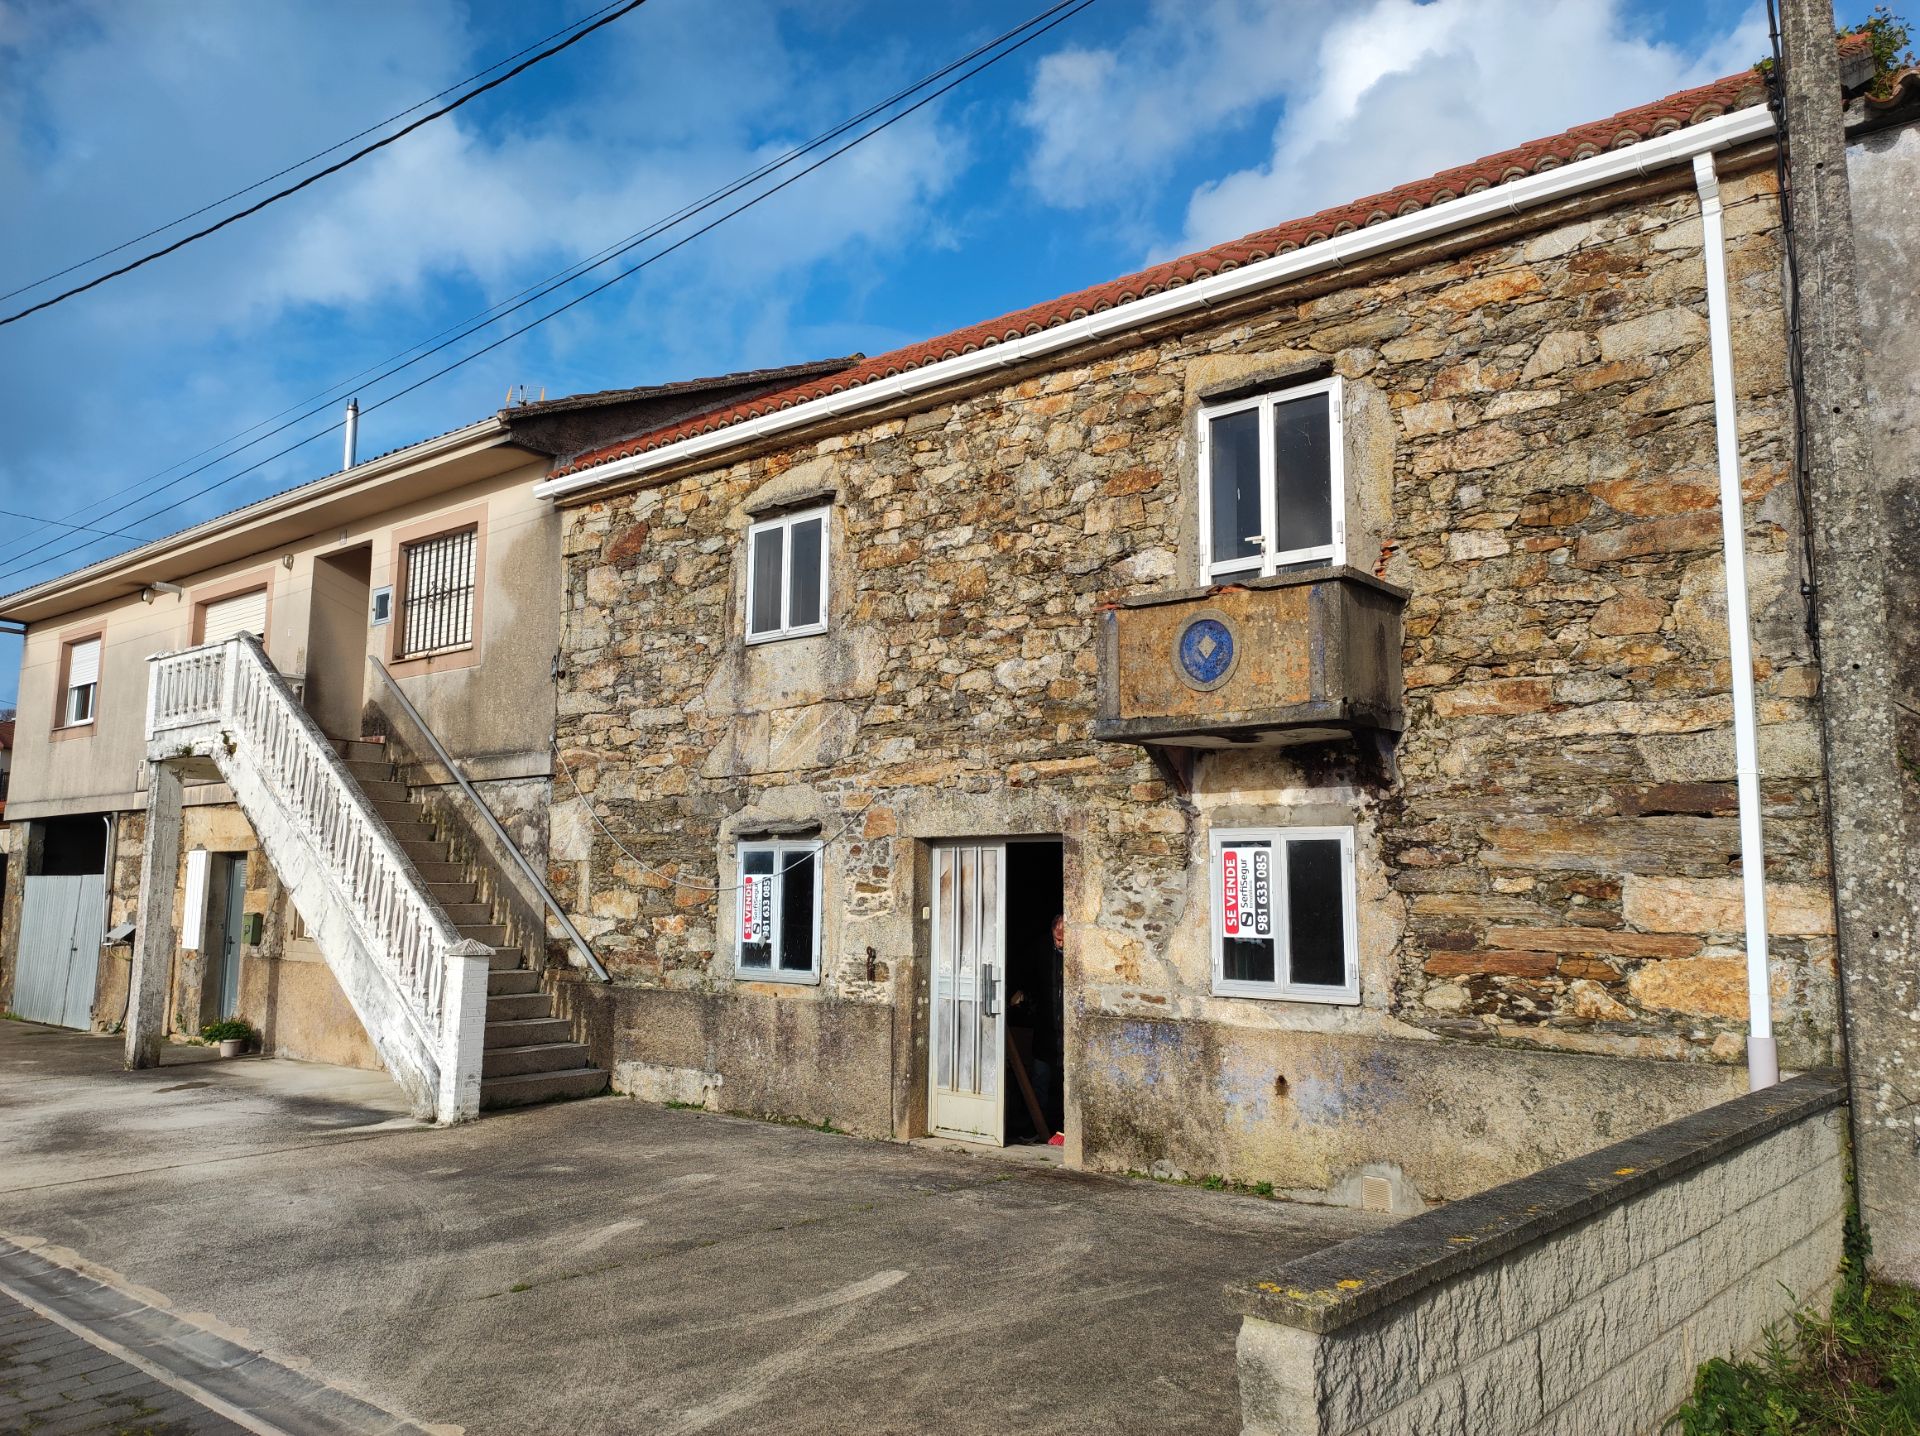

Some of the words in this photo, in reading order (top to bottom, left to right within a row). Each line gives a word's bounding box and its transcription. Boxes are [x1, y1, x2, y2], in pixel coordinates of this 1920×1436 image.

[1255, 854, 1267, 878] 085
[763, 880, 771, 898] 085
[1225, 858, 1237, 907] VENDE
[1240, 858, 1250, 909] SerfiSegur
[1256, 881, 1268, 905] 633
[762, 899, 770, 918] 633
[1226, 909, 1237, 926] SE
[1257, 908, 1269, 931] 981
[744, 922, 751, 934] SE
